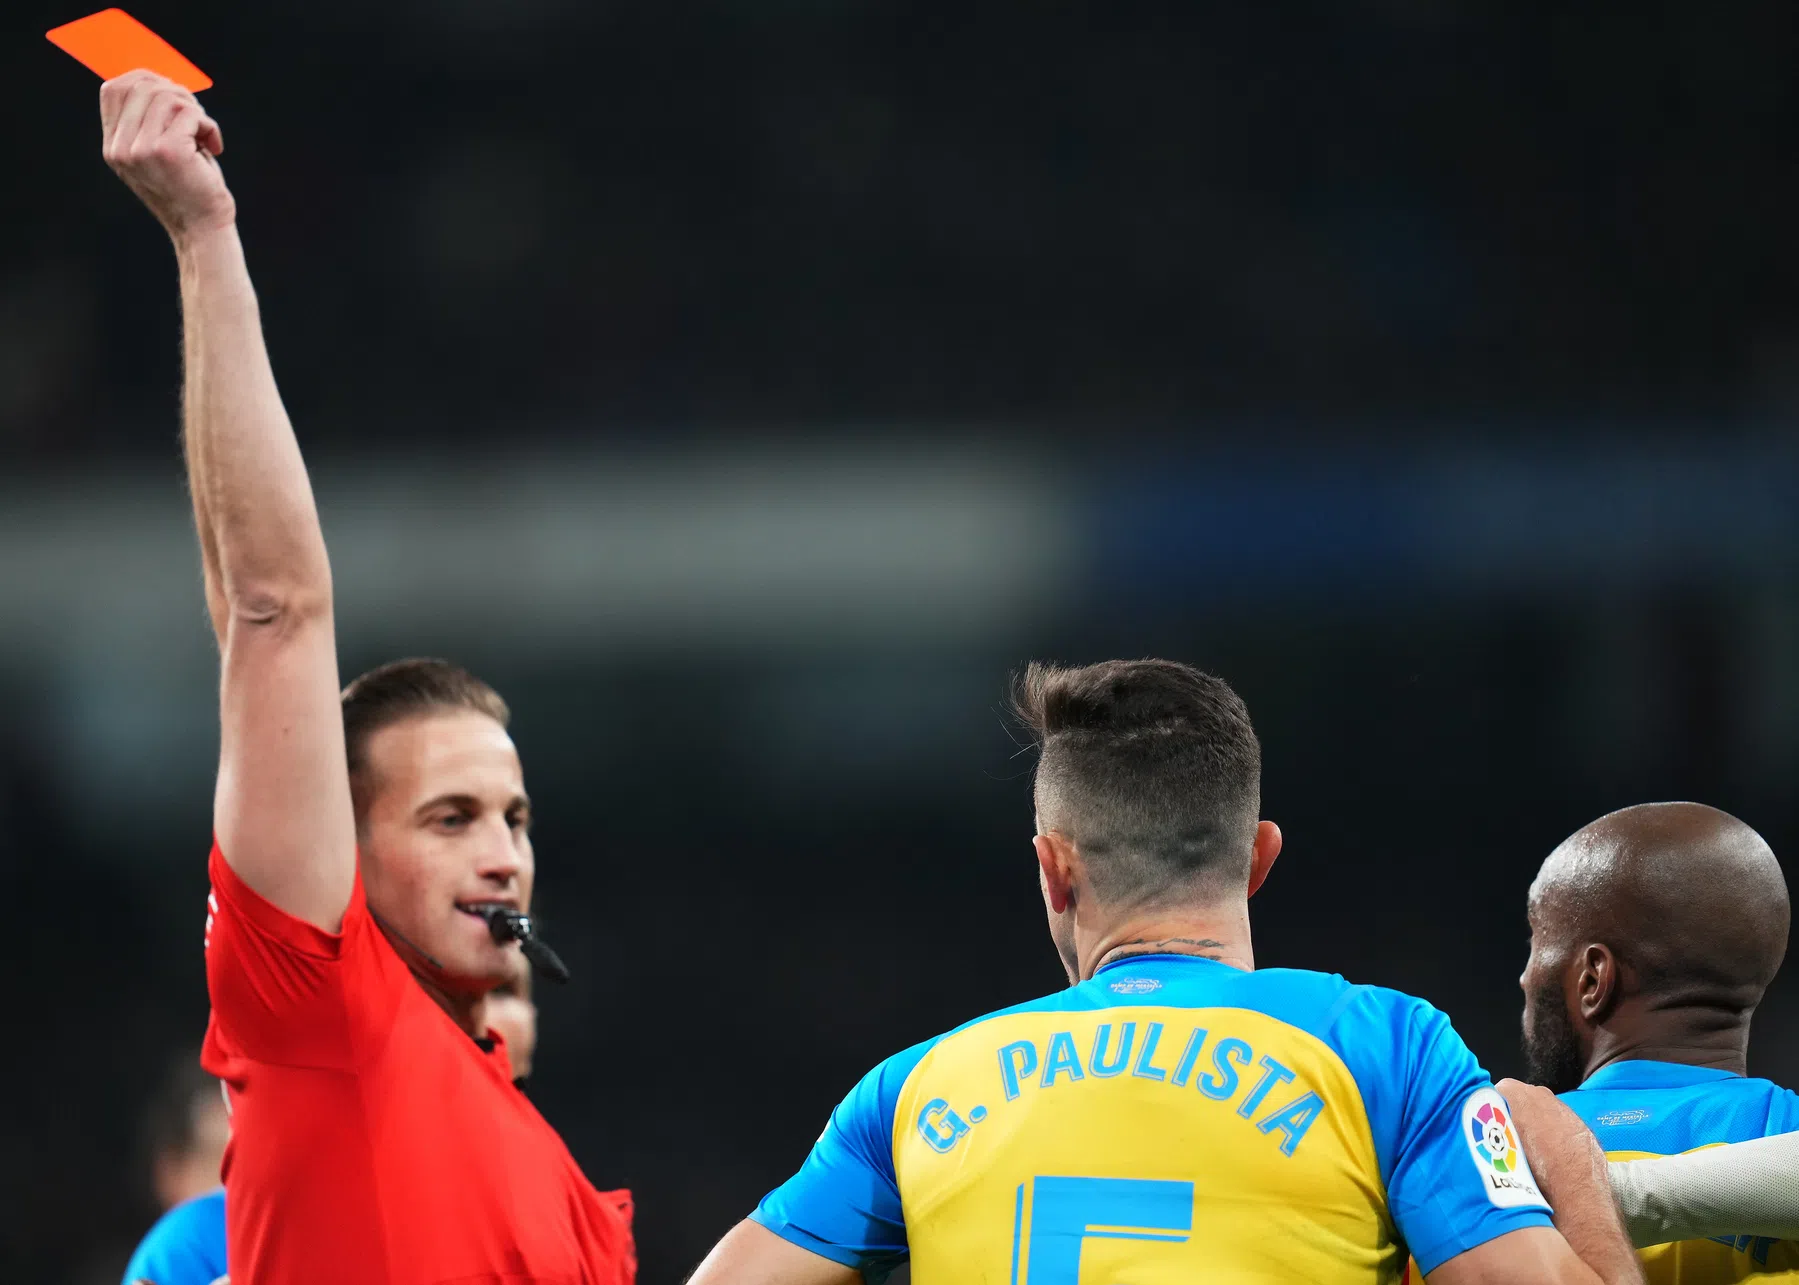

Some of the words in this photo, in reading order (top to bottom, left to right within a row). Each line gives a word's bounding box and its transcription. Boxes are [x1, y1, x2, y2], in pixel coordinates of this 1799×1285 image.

[916, 1097, 988, 1154] G.
[997, 1021, 1326, 1158] PAULISTA
[1489, 1174, 1538, 1196] LaLa
